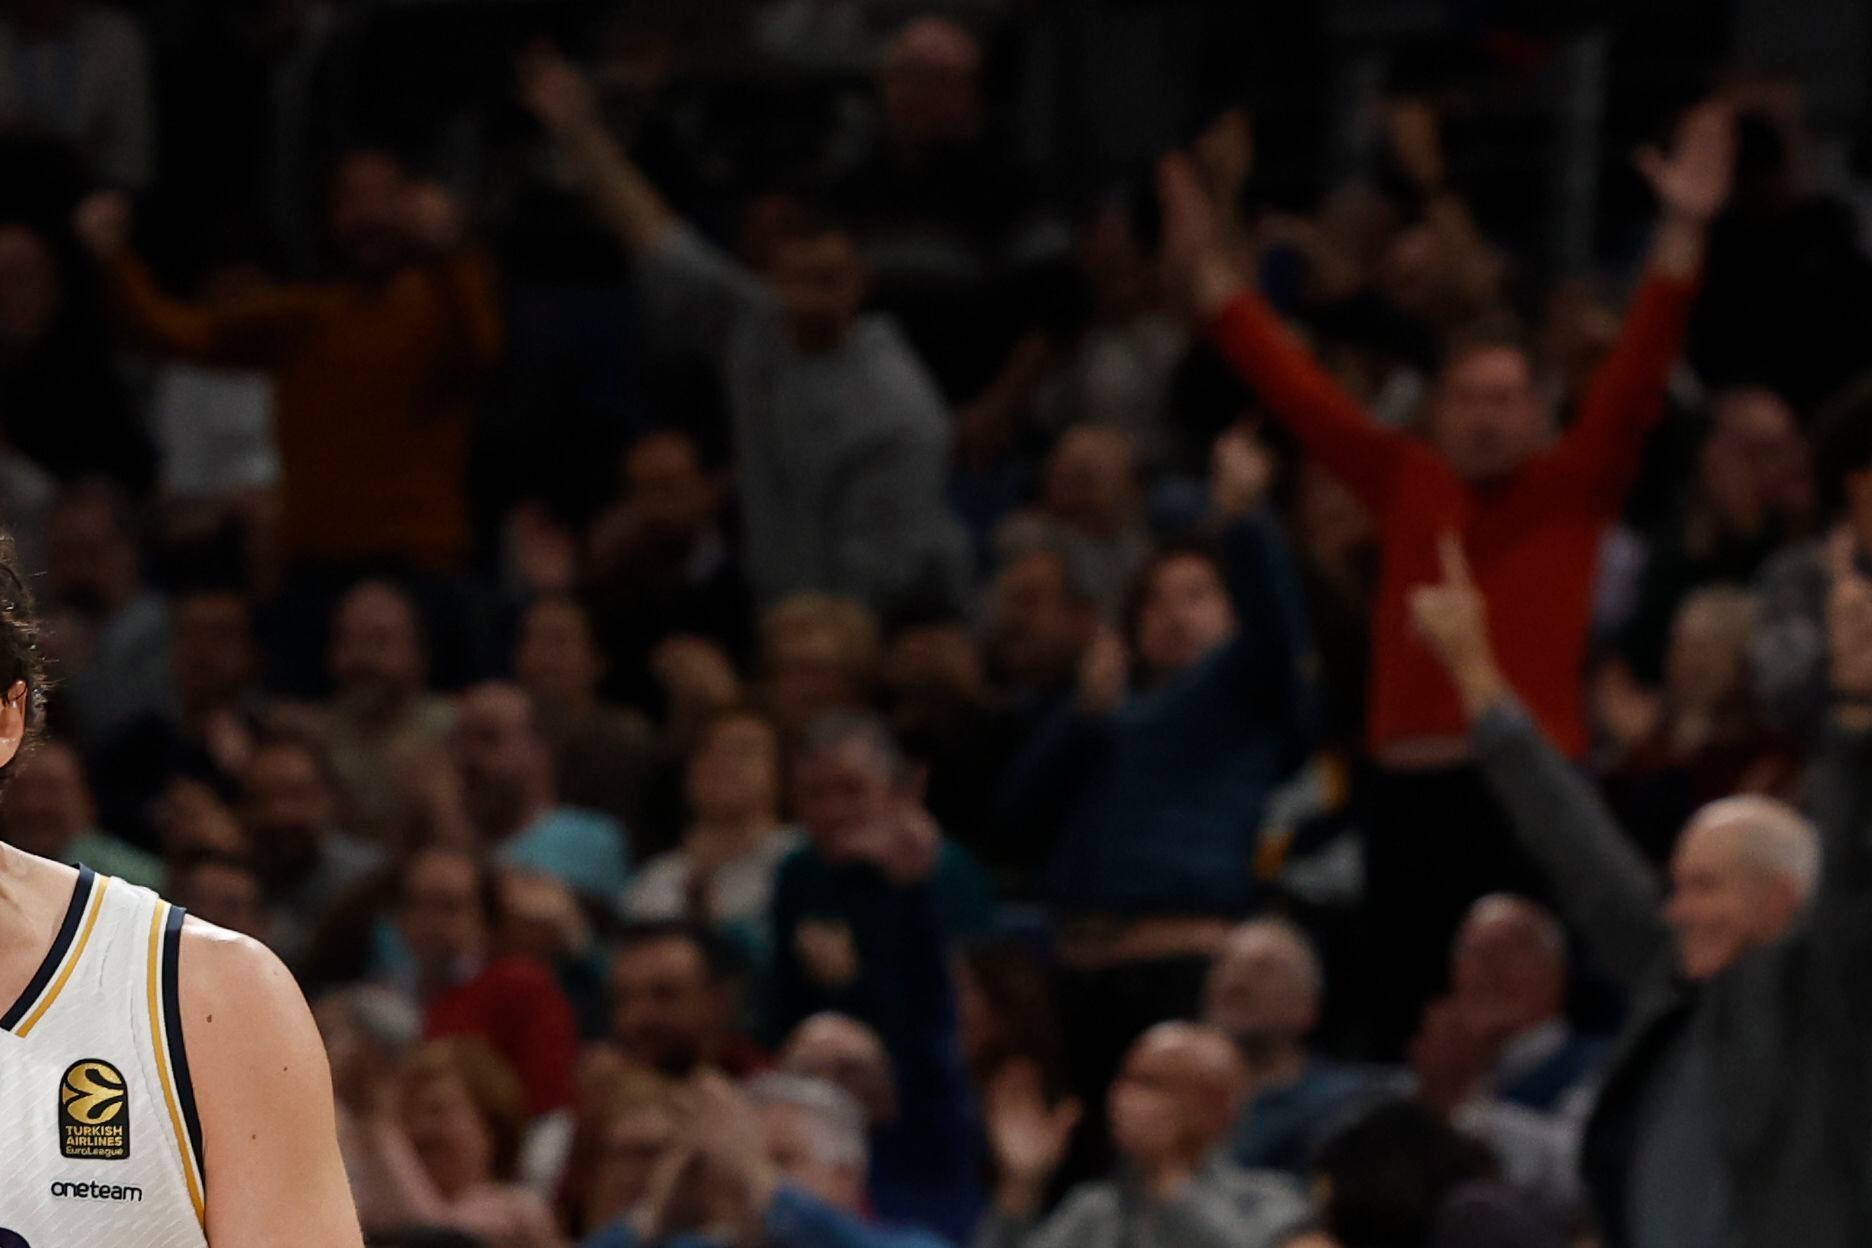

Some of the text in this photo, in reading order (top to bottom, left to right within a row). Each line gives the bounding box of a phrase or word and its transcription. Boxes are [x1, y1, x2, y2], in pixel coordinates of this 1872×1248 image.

[65, 1125, 123, 1136] TURKISH
[66, 1136, 123, 1147] AIRLINES
[65, 1146, 124, 1158] EuroLeague
[51, 1181, 142, 1202] oneteam
